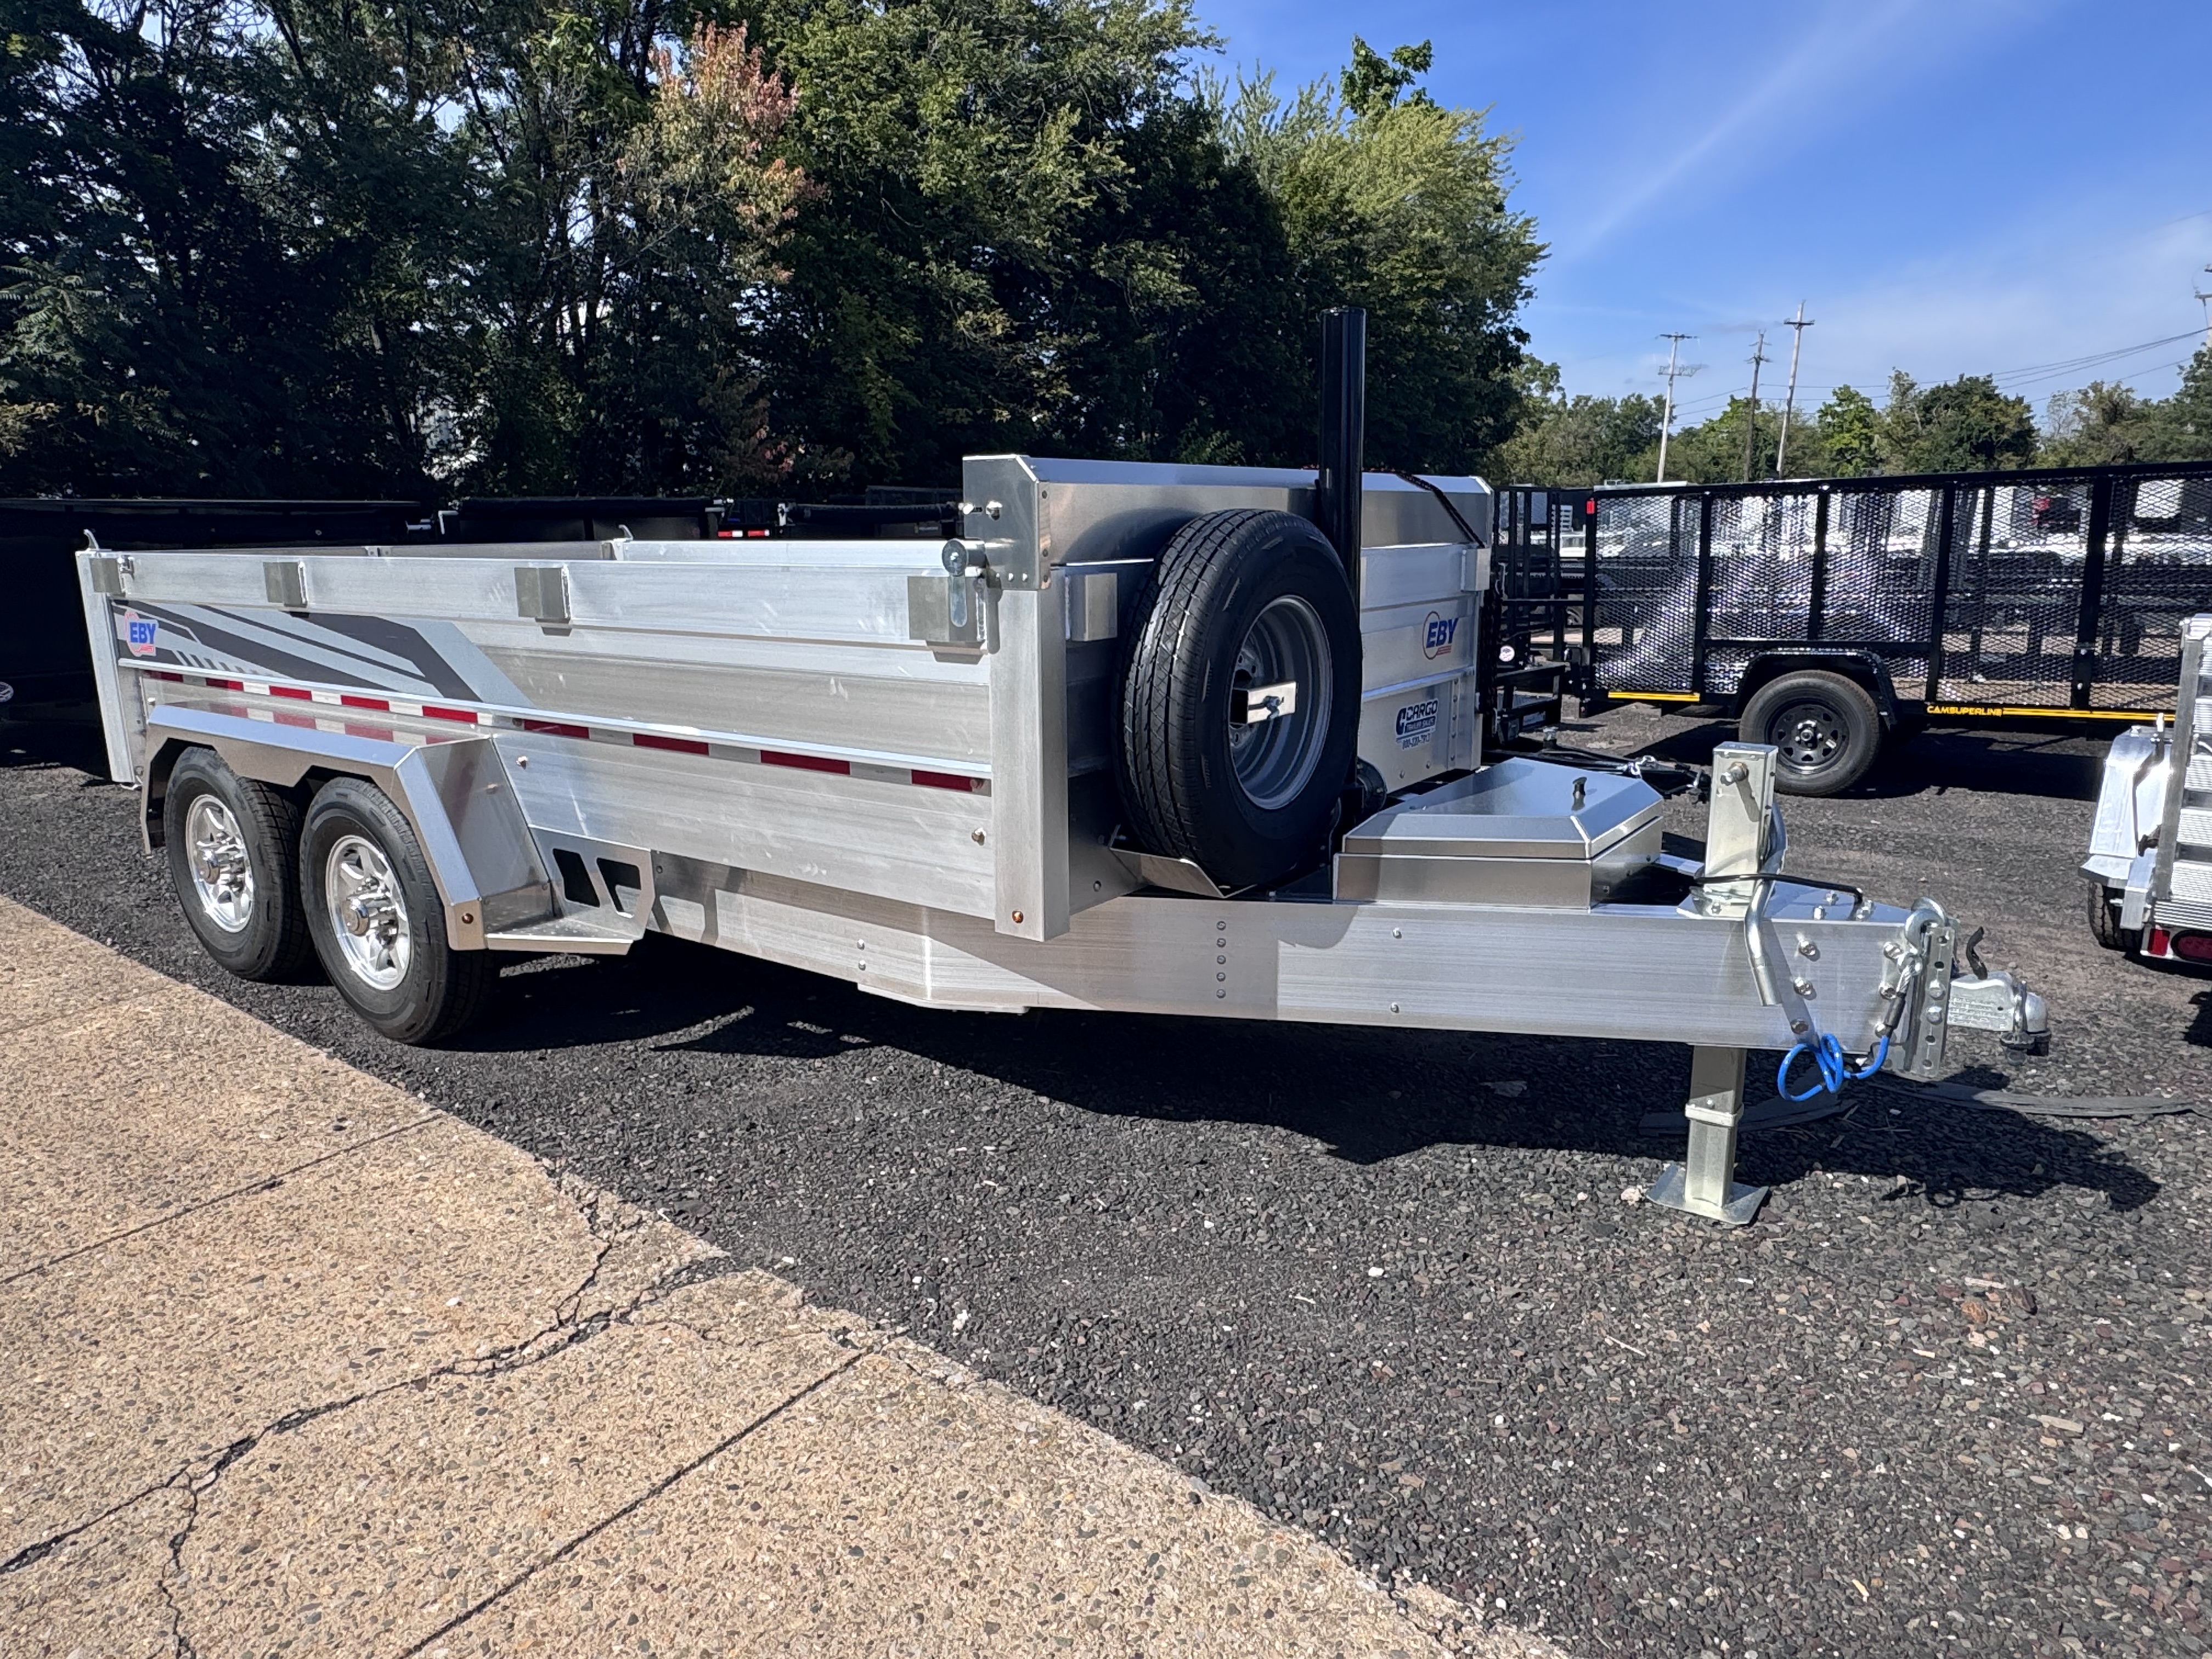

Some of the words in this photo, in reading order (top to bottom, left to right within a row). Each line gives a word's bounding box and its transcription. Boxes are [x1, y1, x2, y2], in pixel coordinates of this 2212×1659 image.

[129, 622, 156, 644] EBY
[1426, 618, 1459, 648] EBY
[1406, 700, 1438, 720] CARGO
